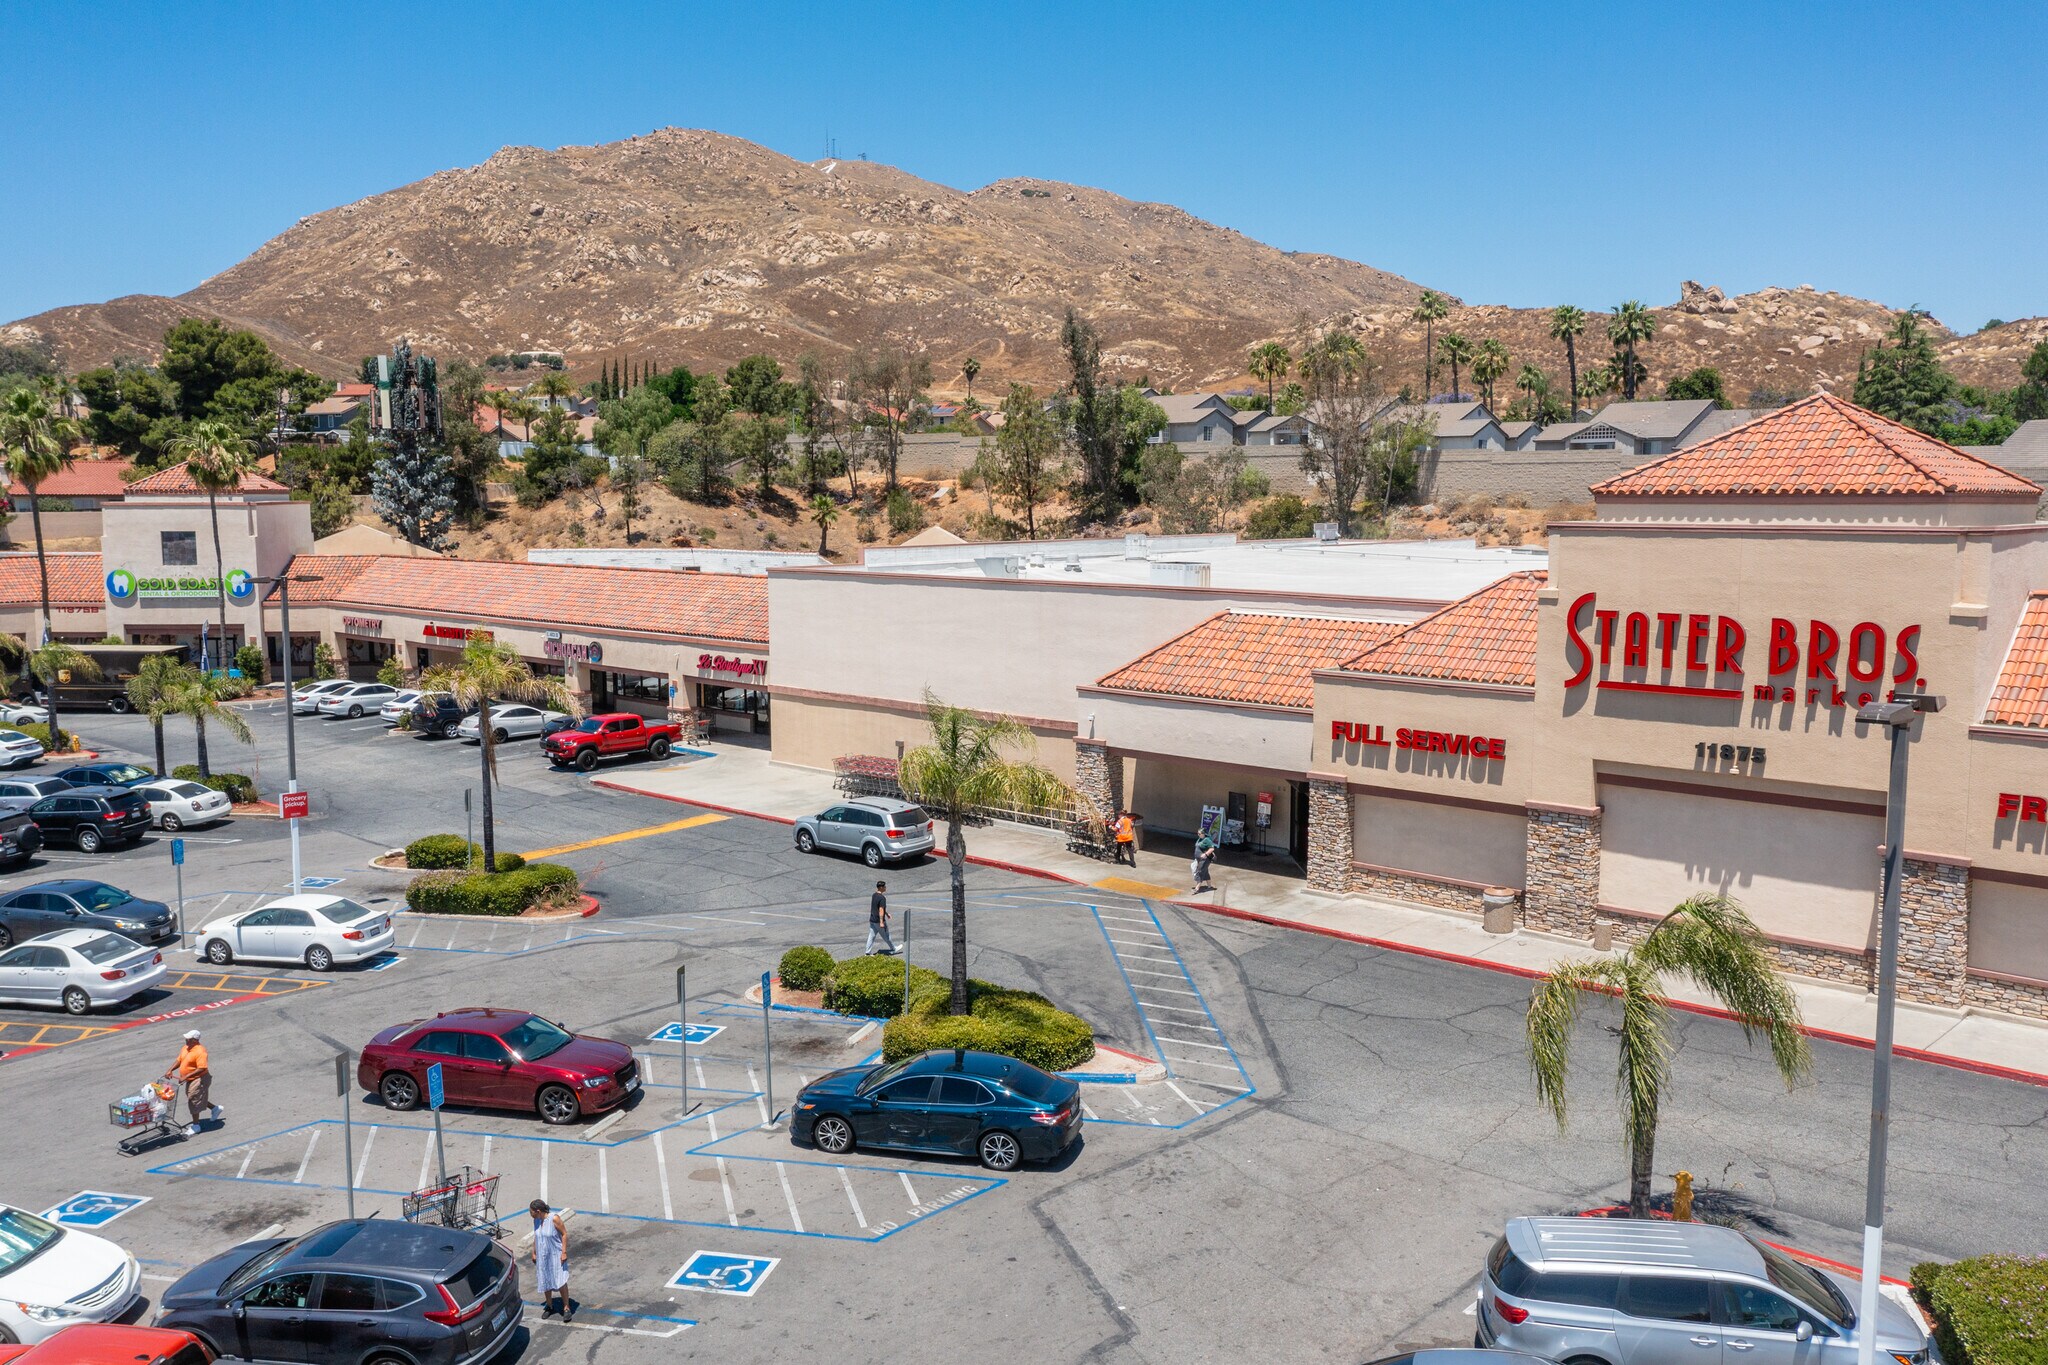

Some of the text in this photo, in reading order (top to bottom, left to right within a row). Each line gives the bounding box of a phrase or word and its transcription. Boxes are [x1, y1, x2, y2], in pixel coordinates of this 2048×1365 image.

[137, 577, 221, 591] GOLD COAST
[343, 616, 382, 629] OPTOMETRY
[1564, 592, 1928, 688] STATER BROS.
[1331, 721, 1506, 760] FULL SERVICE
[1695, 742, 1767, 763] 11875
[146, 998, 234, 1022] PICK UP
[869, 1185, 980, 1236] NO PARKING
